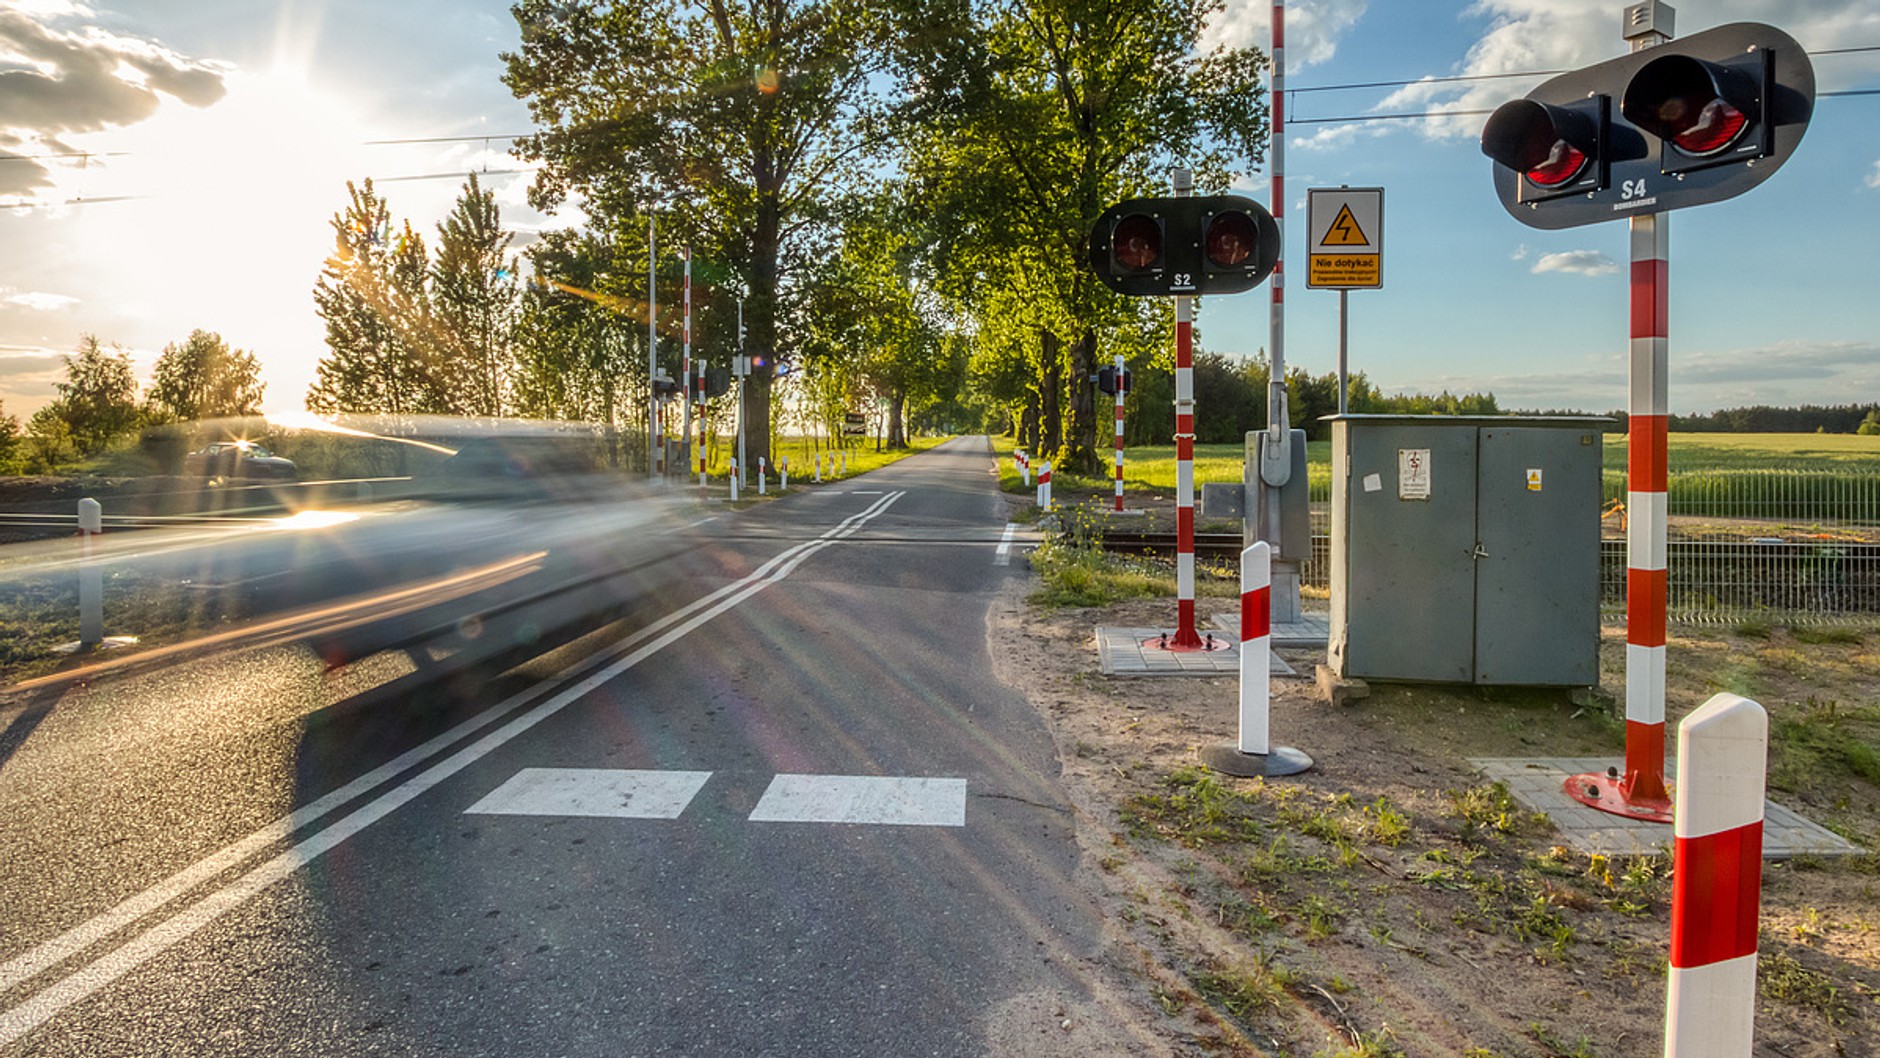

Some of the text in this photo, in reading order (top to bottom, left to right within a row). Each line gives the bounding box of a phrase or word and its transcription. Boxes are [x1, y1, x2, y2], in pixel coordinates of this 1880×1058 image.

[1621, 178, 1647, 199] S4
[1316, 258, 1374, 269] Nie dotykać
[1174, 273, 1191, 286] S2
